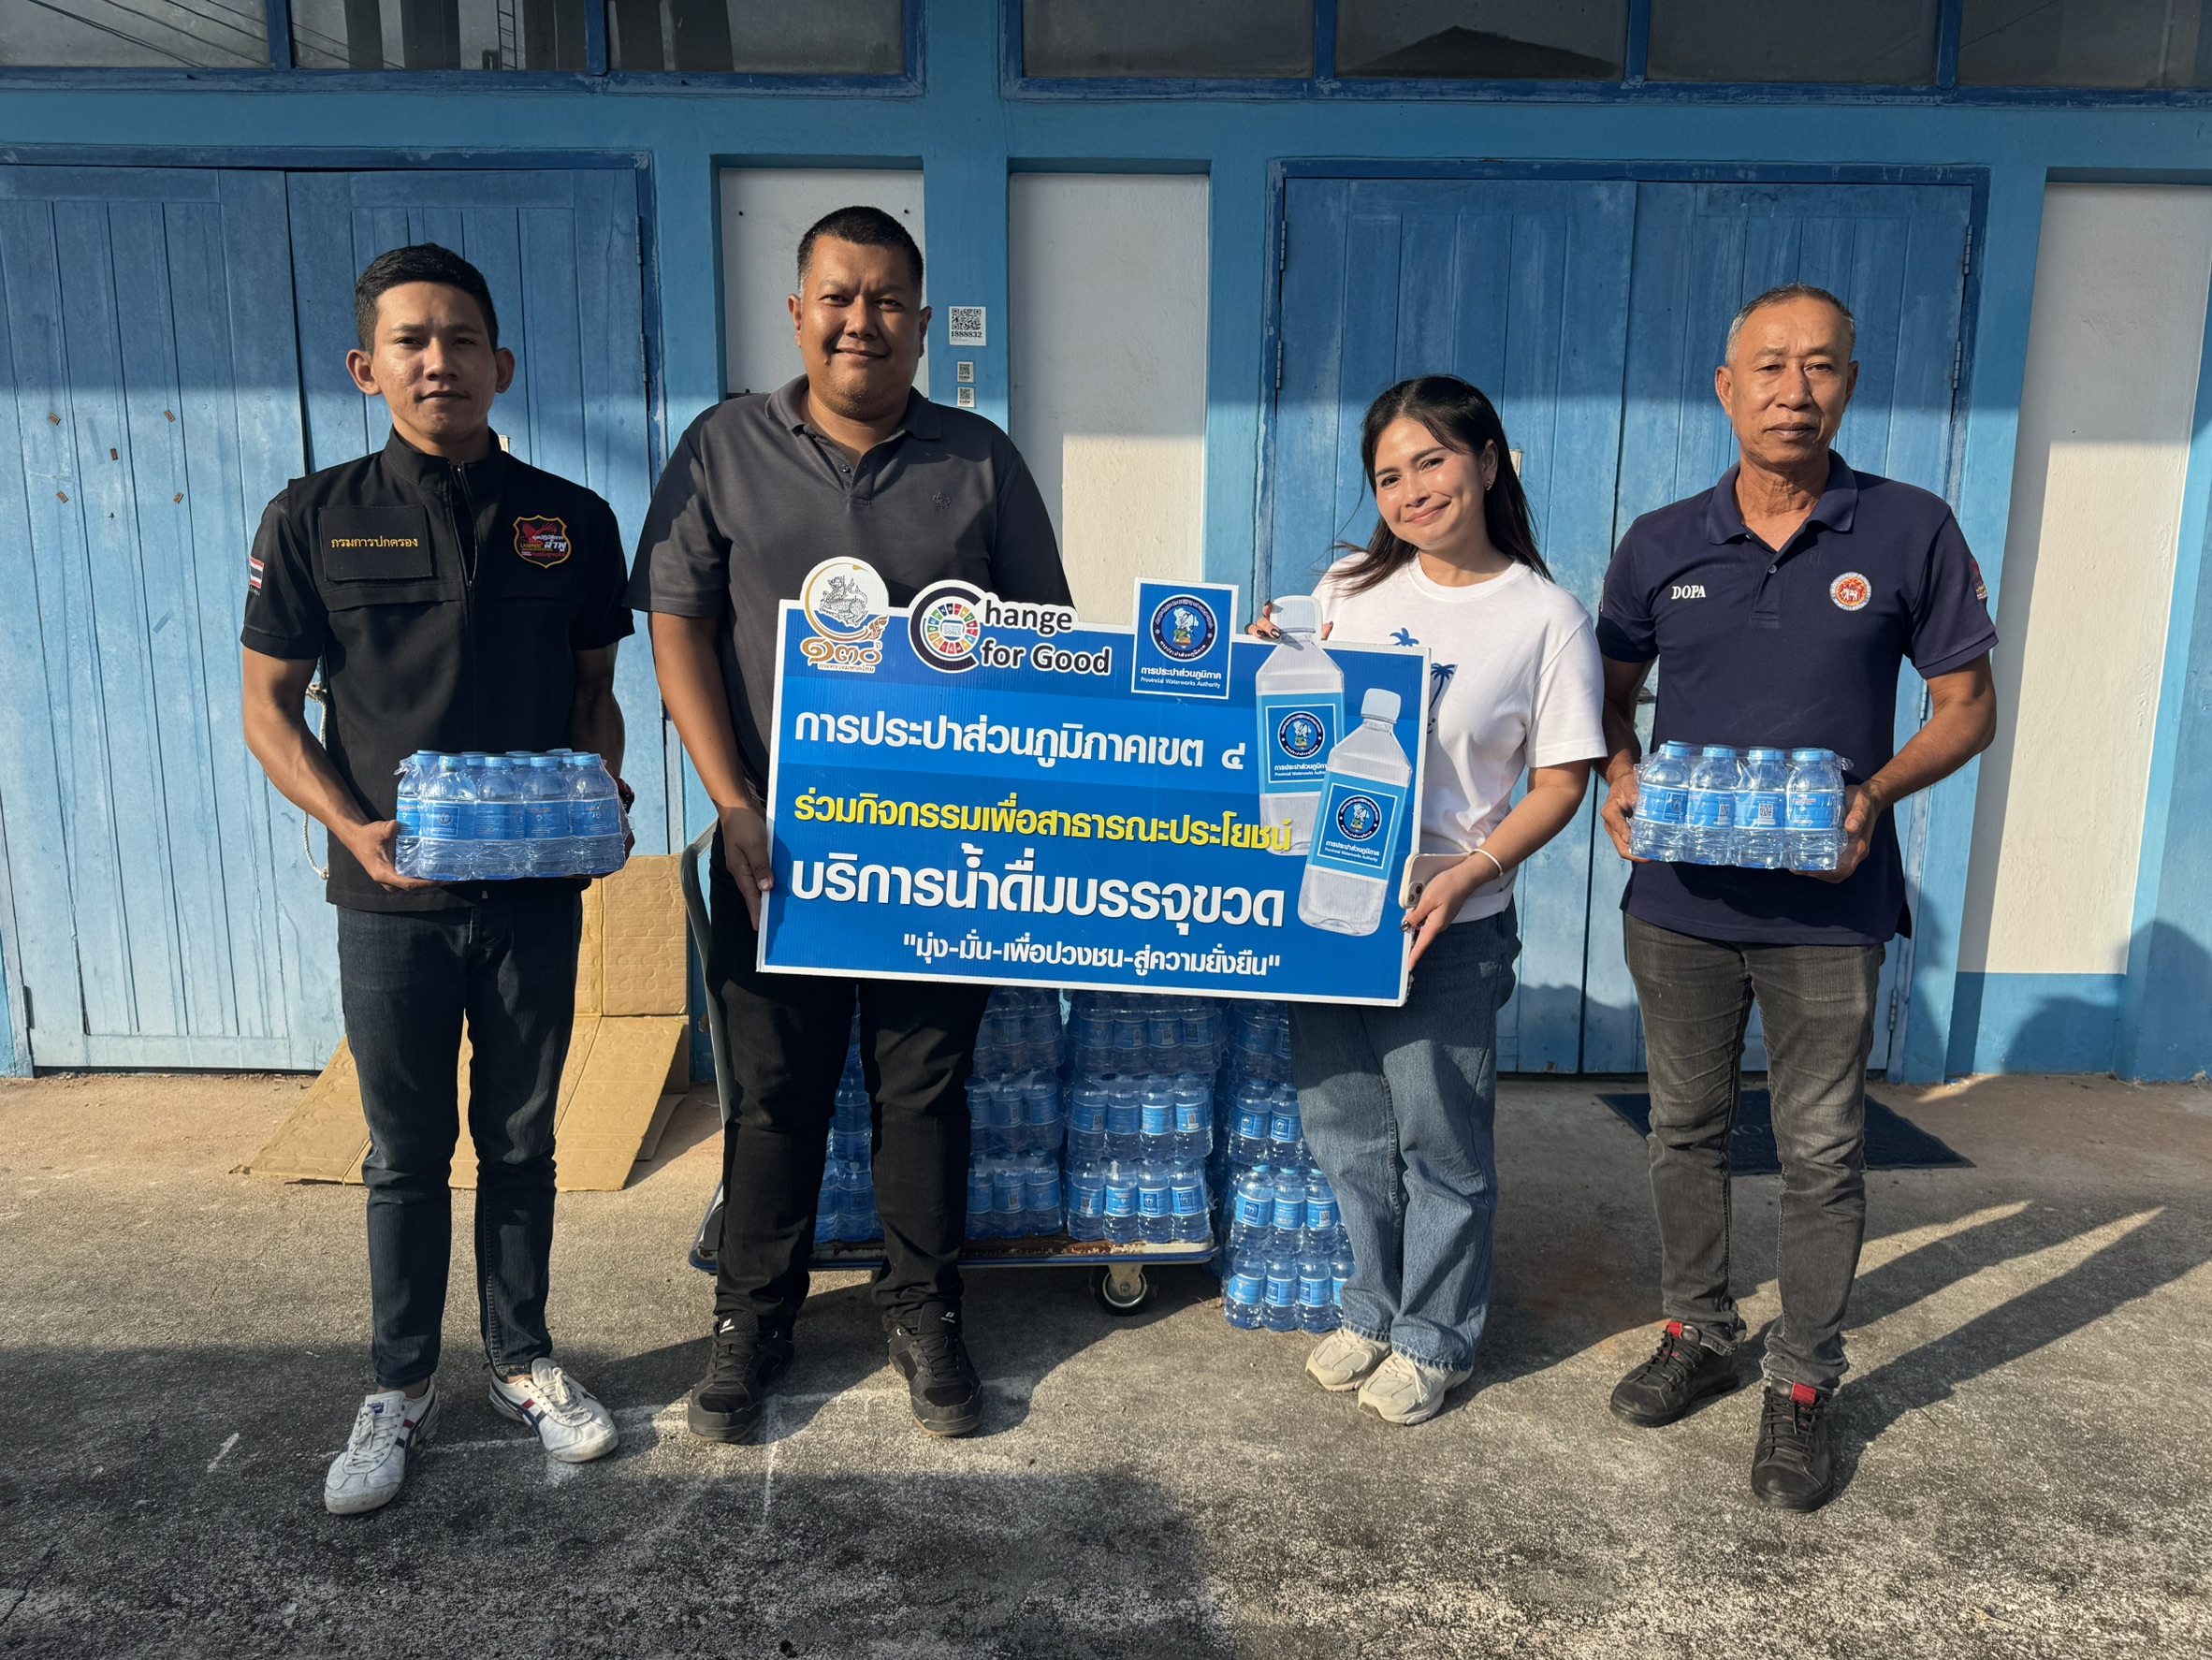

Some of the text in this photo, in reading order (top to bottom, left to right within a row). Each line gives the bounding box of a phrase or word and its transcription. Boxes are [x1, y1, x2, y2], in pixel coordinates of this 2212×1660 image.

[331, 535, 418, 548] กรมการปกครอง
[1670, 585, 1706, 599] DOPA
[982, 640, 1111, 674] for Good
[1141, 666, 1222, 680] การประปาส่วนภูมิภาค
[1165, 678, 1196, 687] Waterworks
[1197, 680, 1221, 689] Authority
[795, 711, 1246, 770] การประปาส่วนภูมิภาคเขต ๔
[1274, 763, 1327, 771] การประปาส่วนภูมิภา
[794, 787, 1292, 851] ร่วมกิจกรรมเพื่อสาธารณะประโยชน์
[792, 842, 1285, 936] บริการน้ำดื่มบรรจุขวด
